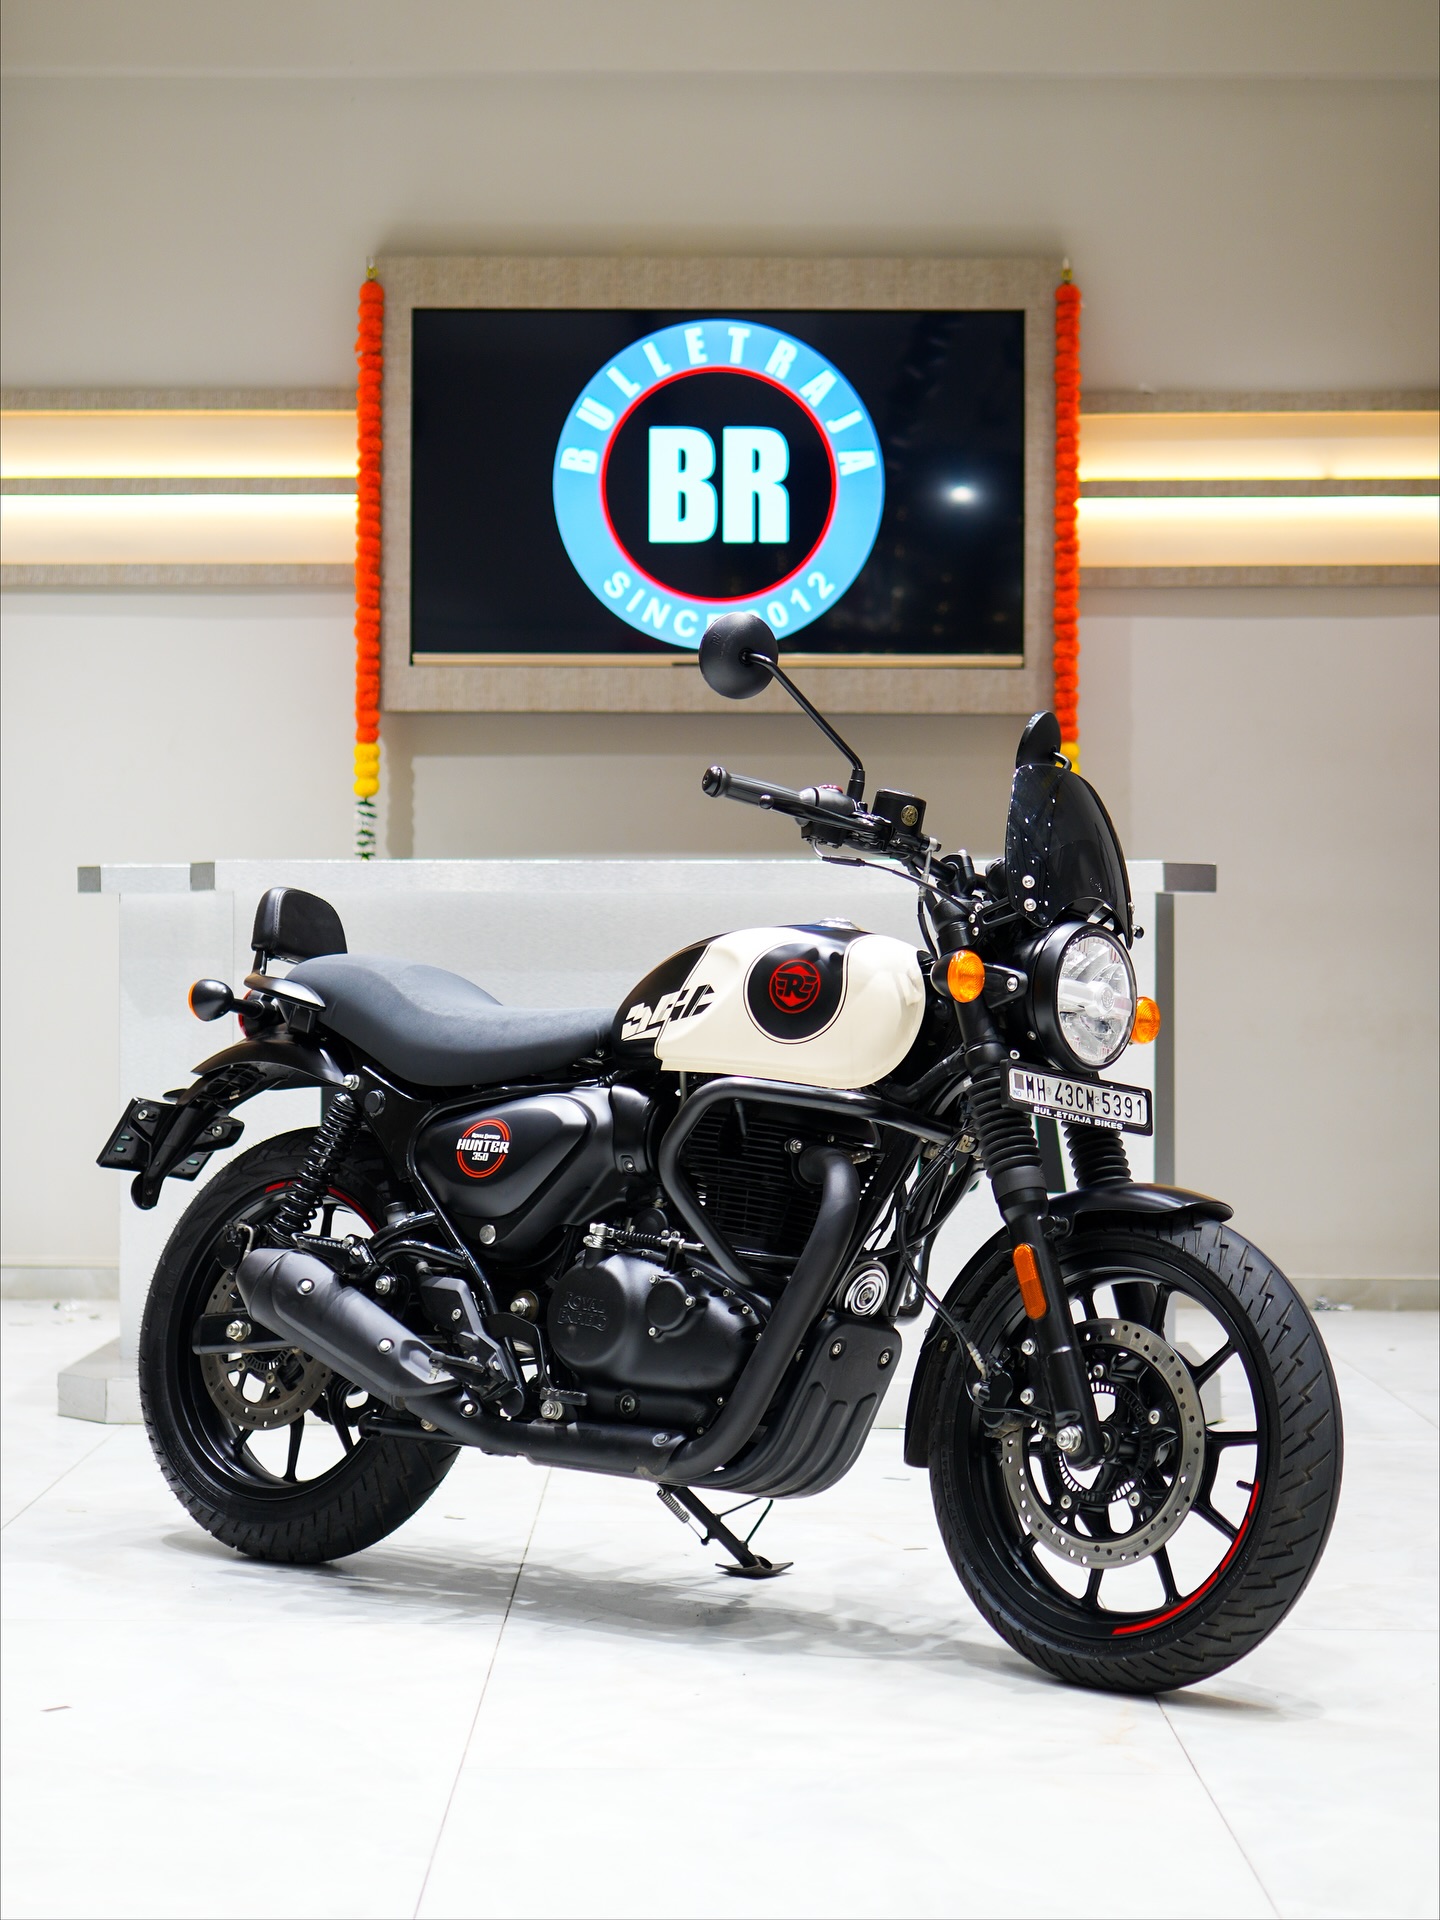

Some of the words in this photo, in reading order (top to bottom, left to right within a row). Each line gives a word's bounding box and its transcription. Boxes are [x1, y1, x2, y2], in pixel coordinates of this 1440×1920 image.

[560, 326, 877, 477] BULLETRAJA
[649, 425, 790, 543] BR
[744, 571, 835, 629] 012
[1025, 1075, 1046, 1101] MH
[1055, 1082, 1094, 1113] 43CN
[1102, 1092, 1142, 1121] 5391
[1033, 1105, 1092, 1125] BULETRAJA
[1094, 1118, 1124, 1131] BIKES
[456, 1138, 510, 1154] HUNTER
[471, 1151, 489, 1162] 350
